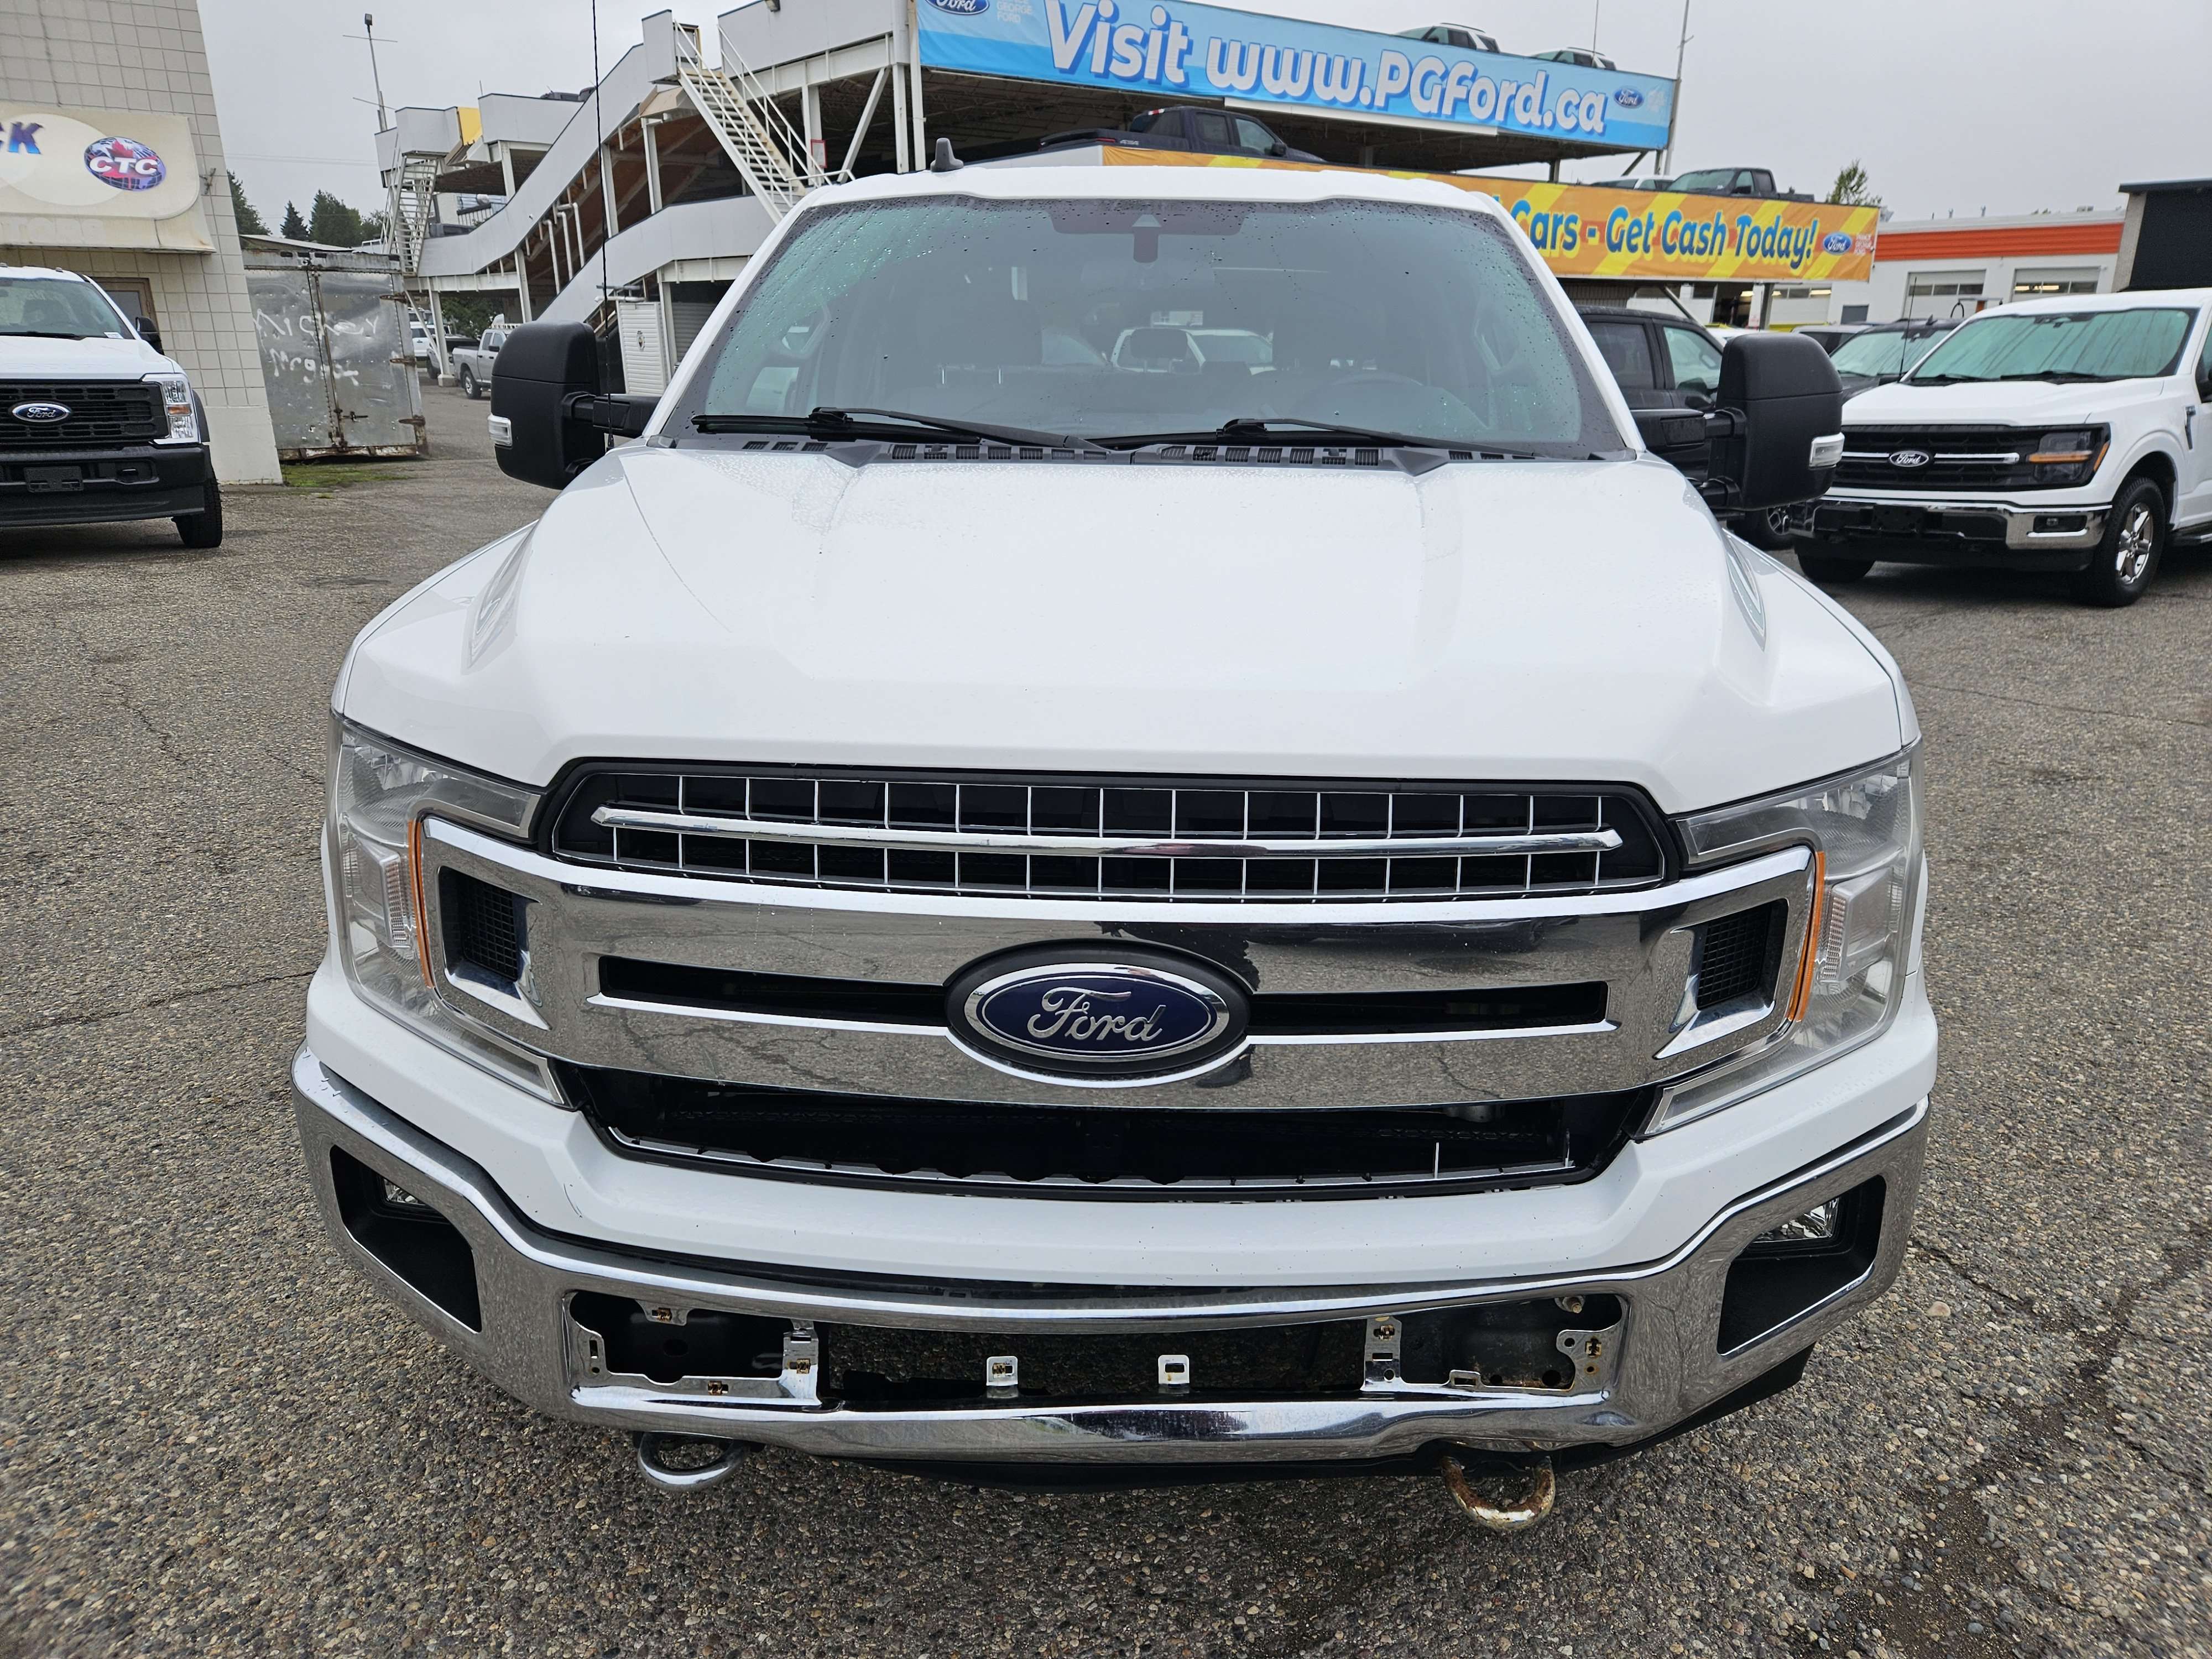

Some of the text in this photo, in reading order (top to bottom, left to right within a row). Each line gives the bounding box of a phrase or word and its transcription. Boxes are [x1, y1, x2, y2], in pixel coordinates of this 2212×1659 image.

[1045, 0, 1606, 134] Visit www.PGFord.ca
[1618, 88, 1639, 107] Ford
[0, 122, 44, 154] K
[89, 156, 158, 175] CTC
[1605, 206, 1655, 254] Get
[1661, 210, 1726, 256] Cash
[1735, 214, 1818, 269] Today!
[1827, 235, 1848, 252] Ford
[27, 406, 56, 419] Ford
[1895, 452, 1922, 465] Ford
[1027, 986, 1167, 1042] Ford
